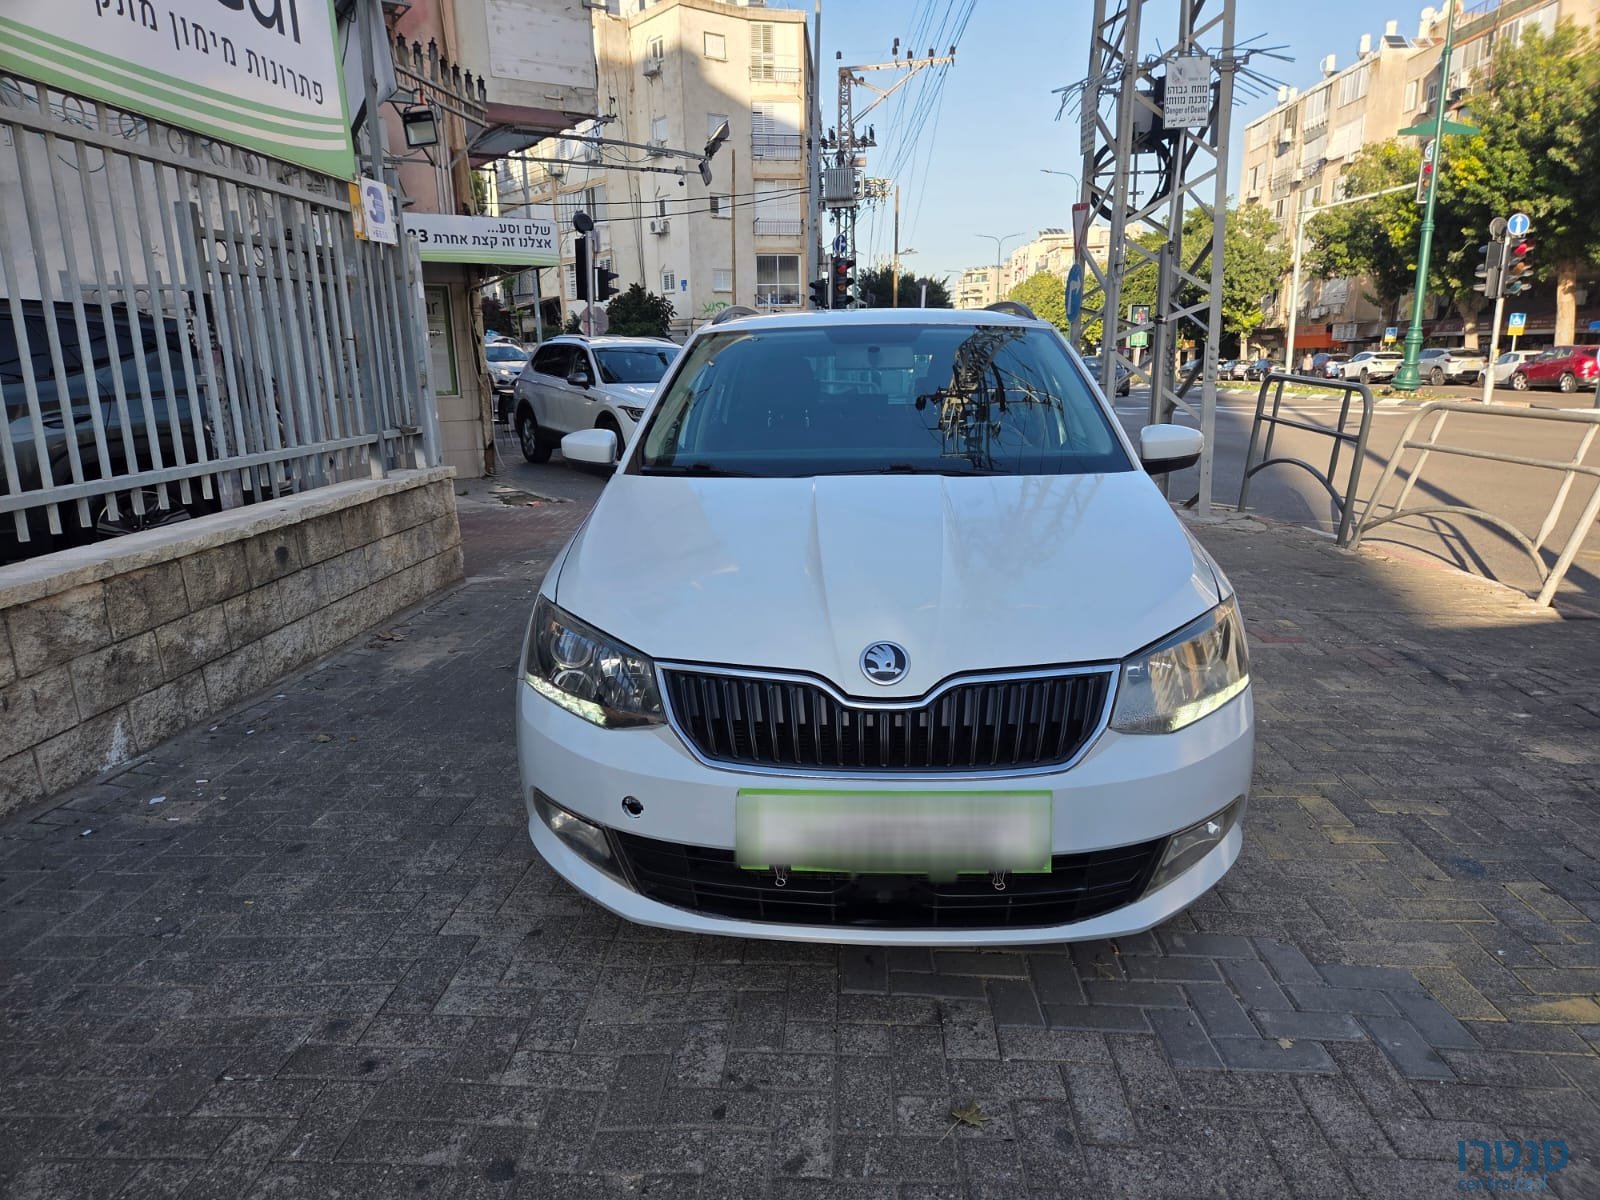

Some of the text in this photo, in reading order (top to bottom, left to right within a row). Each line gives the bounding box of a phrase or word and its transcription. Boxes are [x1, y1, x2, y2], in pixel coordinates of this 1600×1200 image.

[169, 11, 237, 66] מימון
[245, 48, 324, 105] פתרונות
[433, 233, 552, 249] אצלנו זה קצת אחרת
[524, 223, 551, 236] שלם
